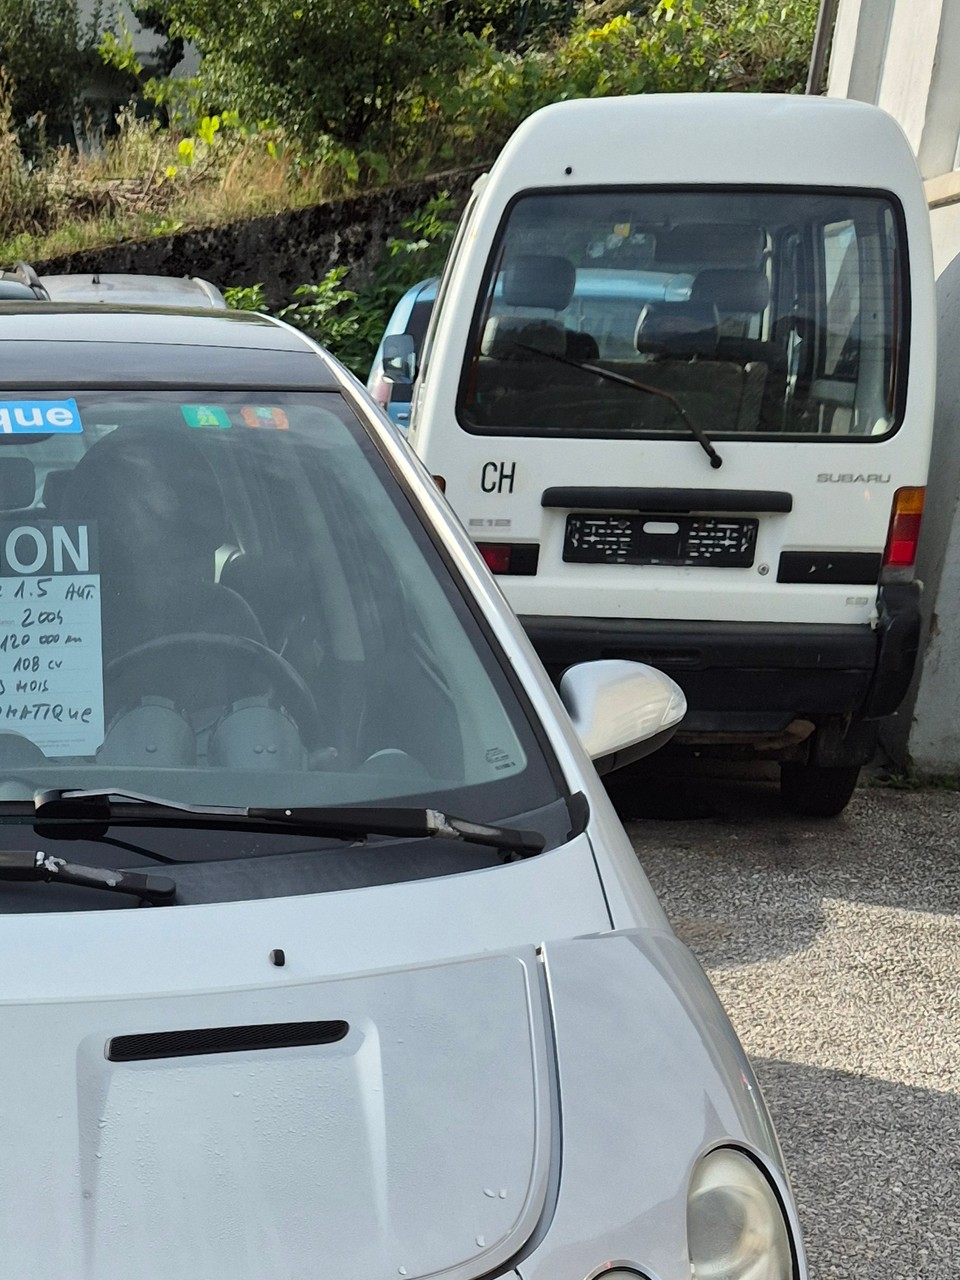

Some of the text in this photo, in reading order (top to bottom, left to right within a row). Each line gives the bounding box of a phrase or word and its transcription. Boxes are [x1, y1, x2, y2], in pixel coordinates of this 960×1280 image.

[481, 461, 516, 494] CH
[816, 473, 891, 484] SUBARU
[468, 518, 511, 527] E12
[13, 577, 53, 600] 1.5
[0, 633, 31, 652] 120
[13, 655, 40, 673] 108
